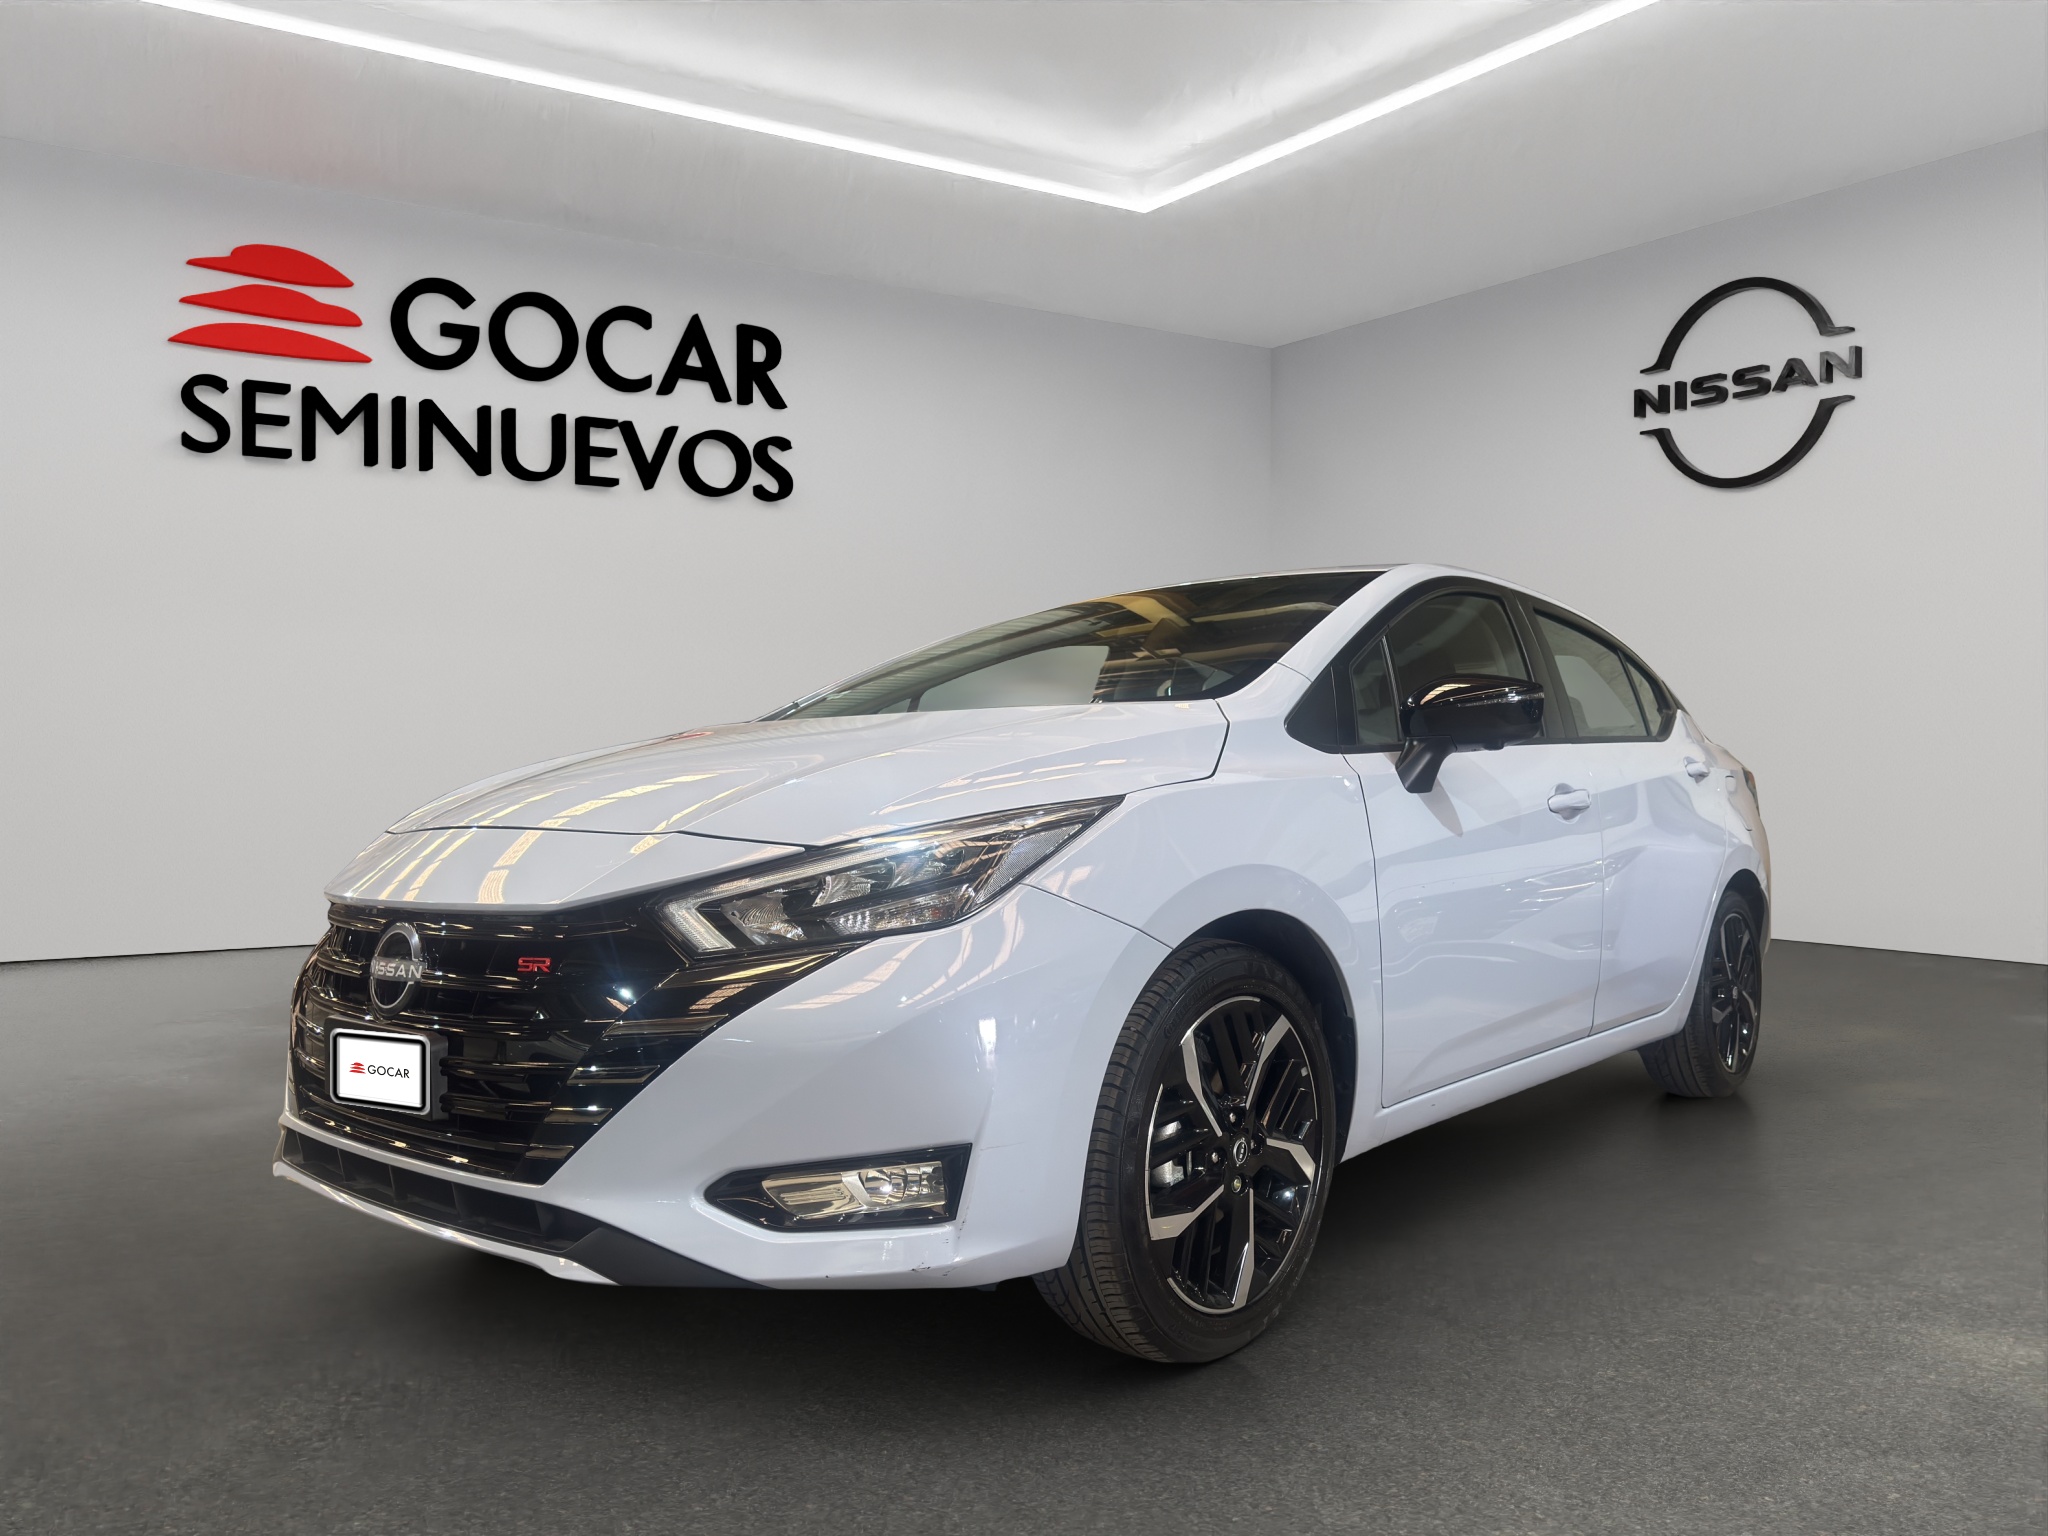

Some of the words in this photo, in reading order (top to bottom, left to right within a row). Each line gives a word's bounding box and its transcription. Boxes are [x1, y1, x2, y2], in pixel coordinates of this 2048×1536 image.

[390, 277, 788, 410] GOCAR
[1633, 345, 1863, 418] NISSAN
[180, 374, 795, 503] SEMINUEVOS
[369, 961, 423, 980] NISSAN
[517, 957, 552, 973] SR
[367, 1064, 410, 1079] GOCAR
